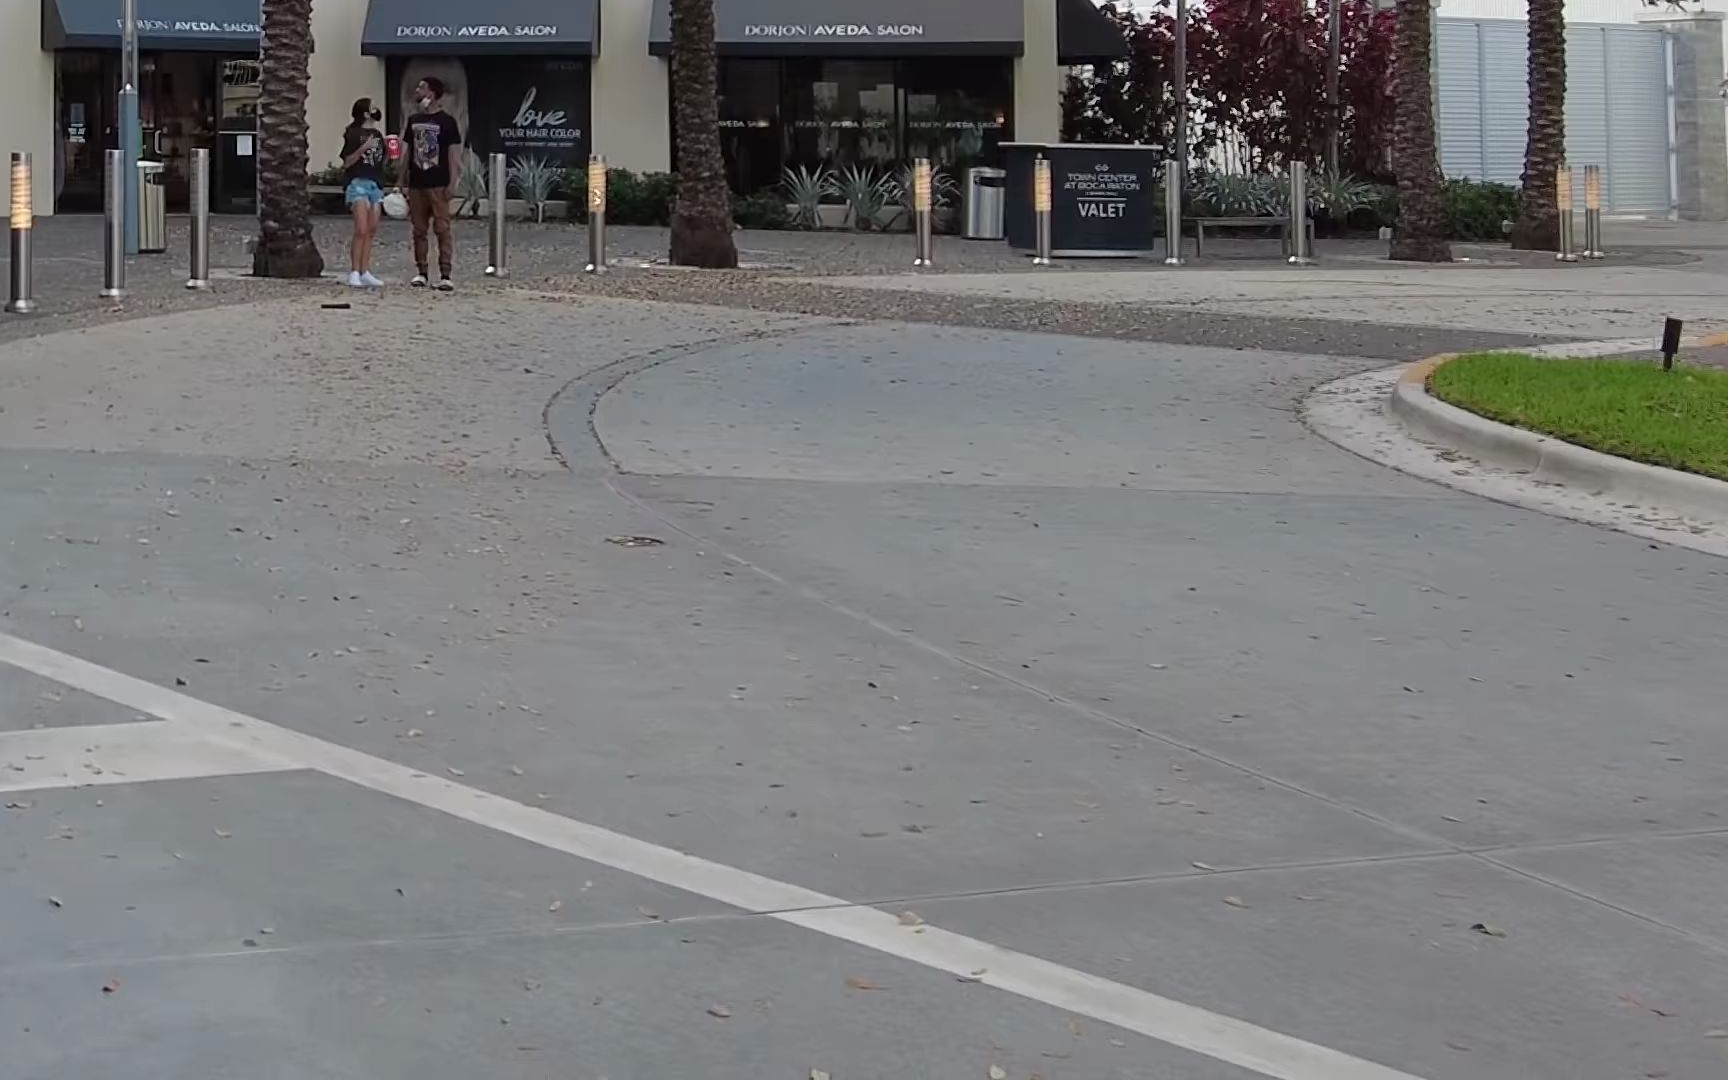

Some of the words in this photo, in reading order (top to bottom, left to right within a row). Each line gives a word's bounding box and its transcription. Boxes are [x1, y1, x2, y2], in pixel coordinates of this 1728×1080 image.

[174, 21, 222, 31] AVEDA
[396, 25, 452, 37] DORJON
[458, 25, 511, 36] AVEDA
[514, 25, 557, 36] SALON
[745, 25, 806, 37] DORJON
[813, 25, 872, 36] AVEDA
[877, 25, 923, 36] SALON
[512, 86, 567, 127] love
[499, 128, 524, 138] YOUR
[526, 128, 548, 138] HAIR
[550, 128, 581, 138] COLOR
[1078, 202, 1127, 217] VALET
